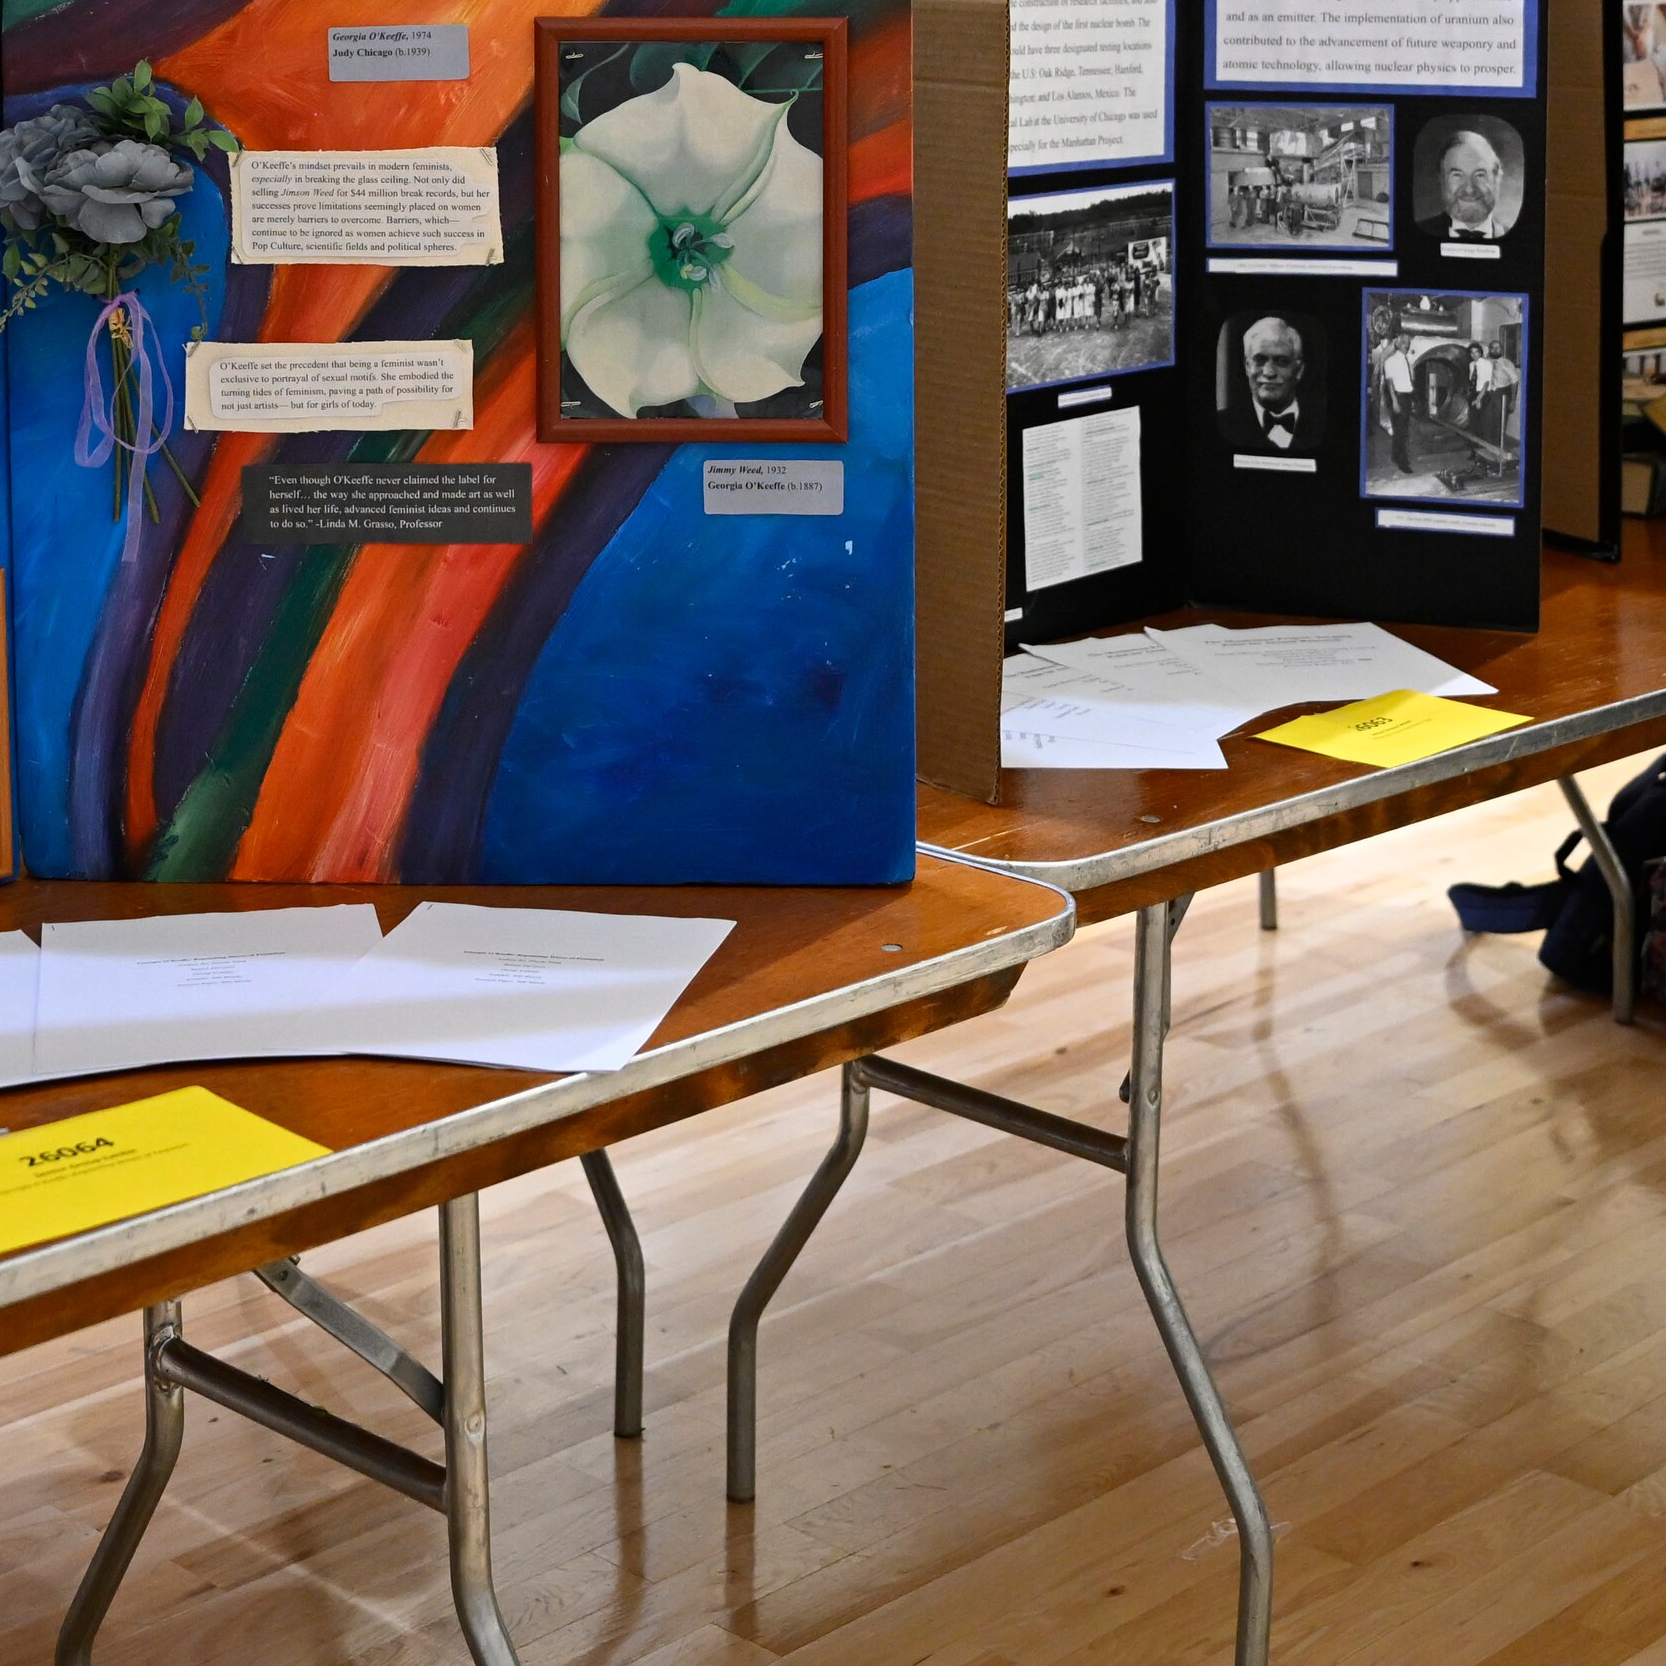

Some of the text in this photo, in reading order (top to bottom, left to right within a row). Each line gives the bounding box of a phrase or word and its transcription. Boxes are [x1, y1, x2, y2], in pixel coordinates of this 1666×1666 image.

[332, 32, 367, 43] Georgia
[411, 31, 431, 40] 1974
[332, 48, 355, 59] Judy
[356, 48, 393, 59] Chicago
[706, 465, 737, 476] Jimmy
[766, 465, 788, 475] 1932
[707, 480, 743, 492] Georgia
[18, 1137, 115, 1168] 26064
